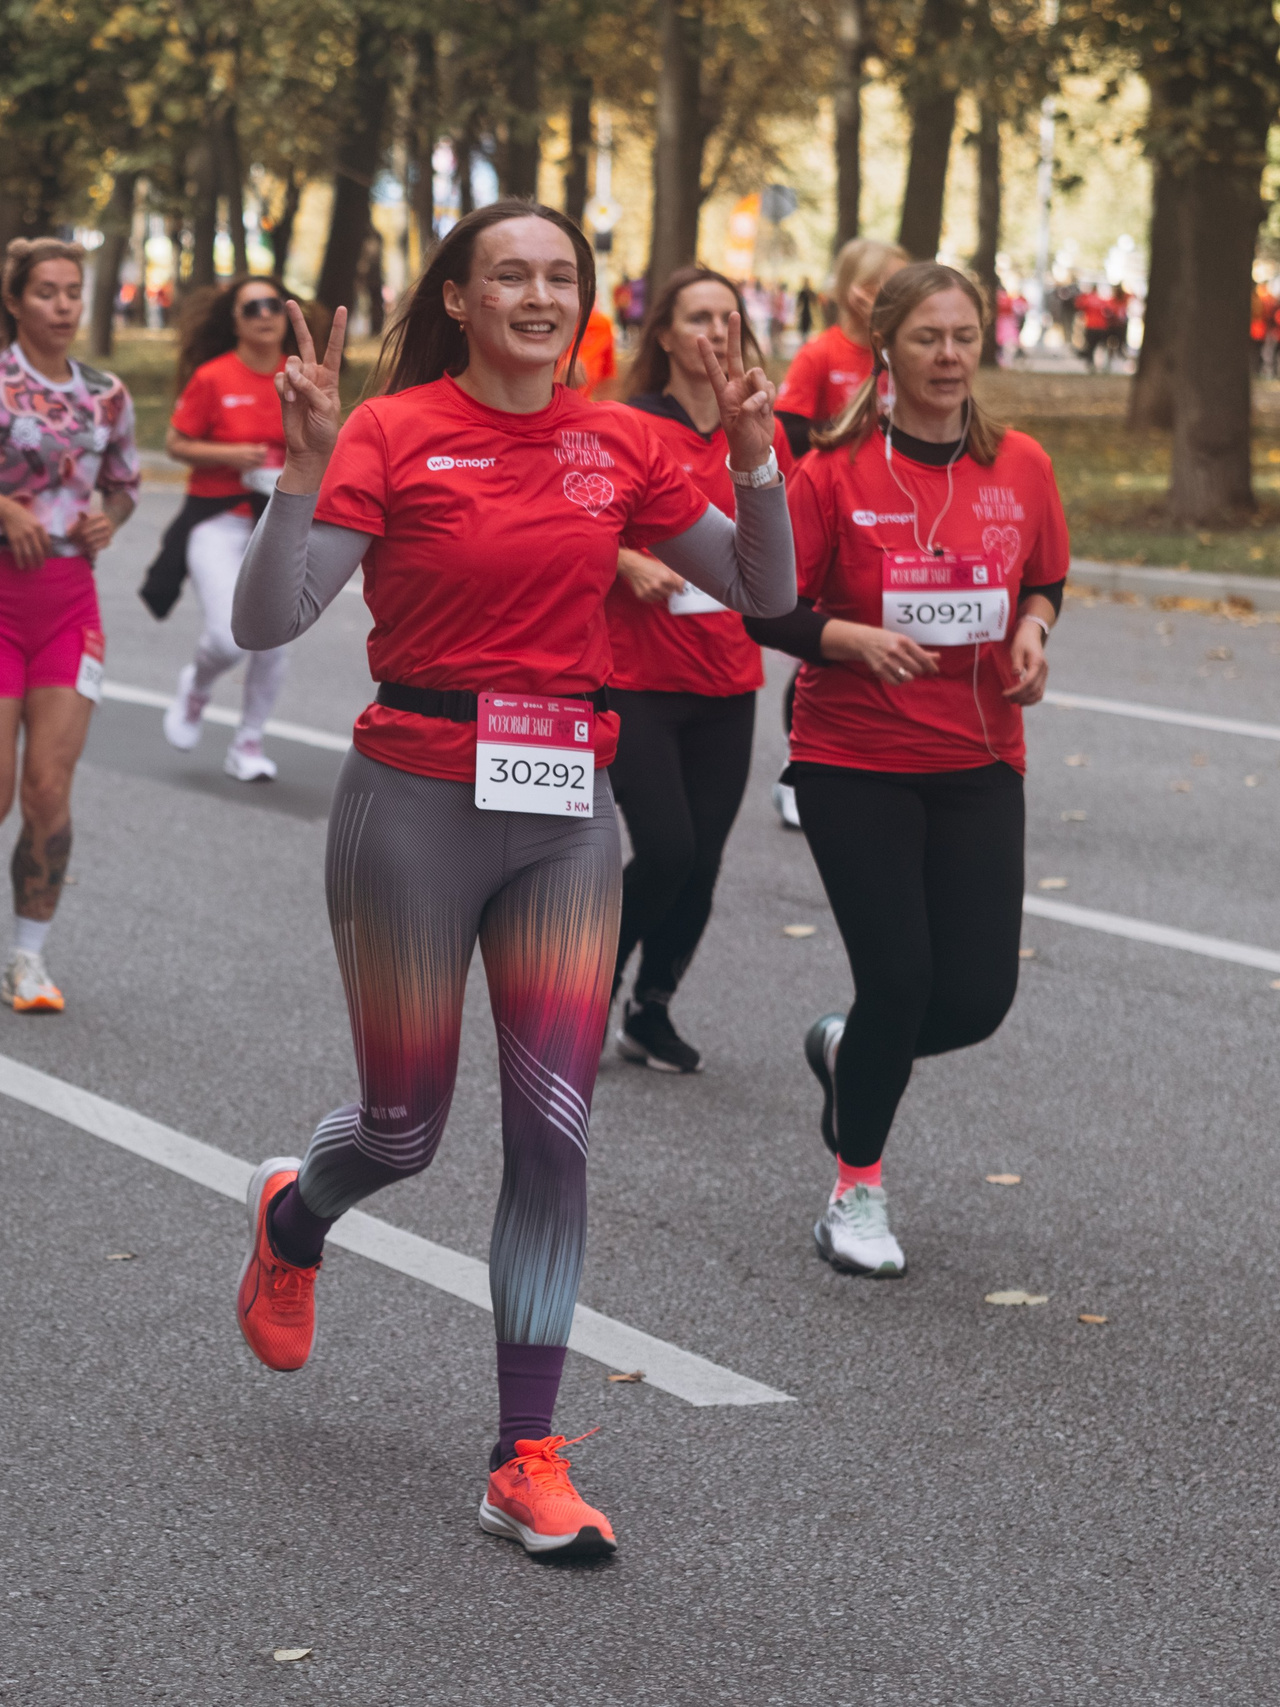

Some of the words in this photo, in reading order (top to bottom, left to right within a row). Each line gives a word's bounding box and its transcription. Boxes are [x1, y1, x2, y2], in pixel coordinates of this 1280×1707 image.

[455, 457, 496, 470] спорт
[896, 602, 982, 625] 30921
[488, 713, 530, 735] РОЗОВЫЙ
[530, 717, 554, 737] ЗАБЕГ
[489, 758, 585, 790] 30292
[565, 801, 572, 811] 3
[388, 1104, 407, 1119] NOW
